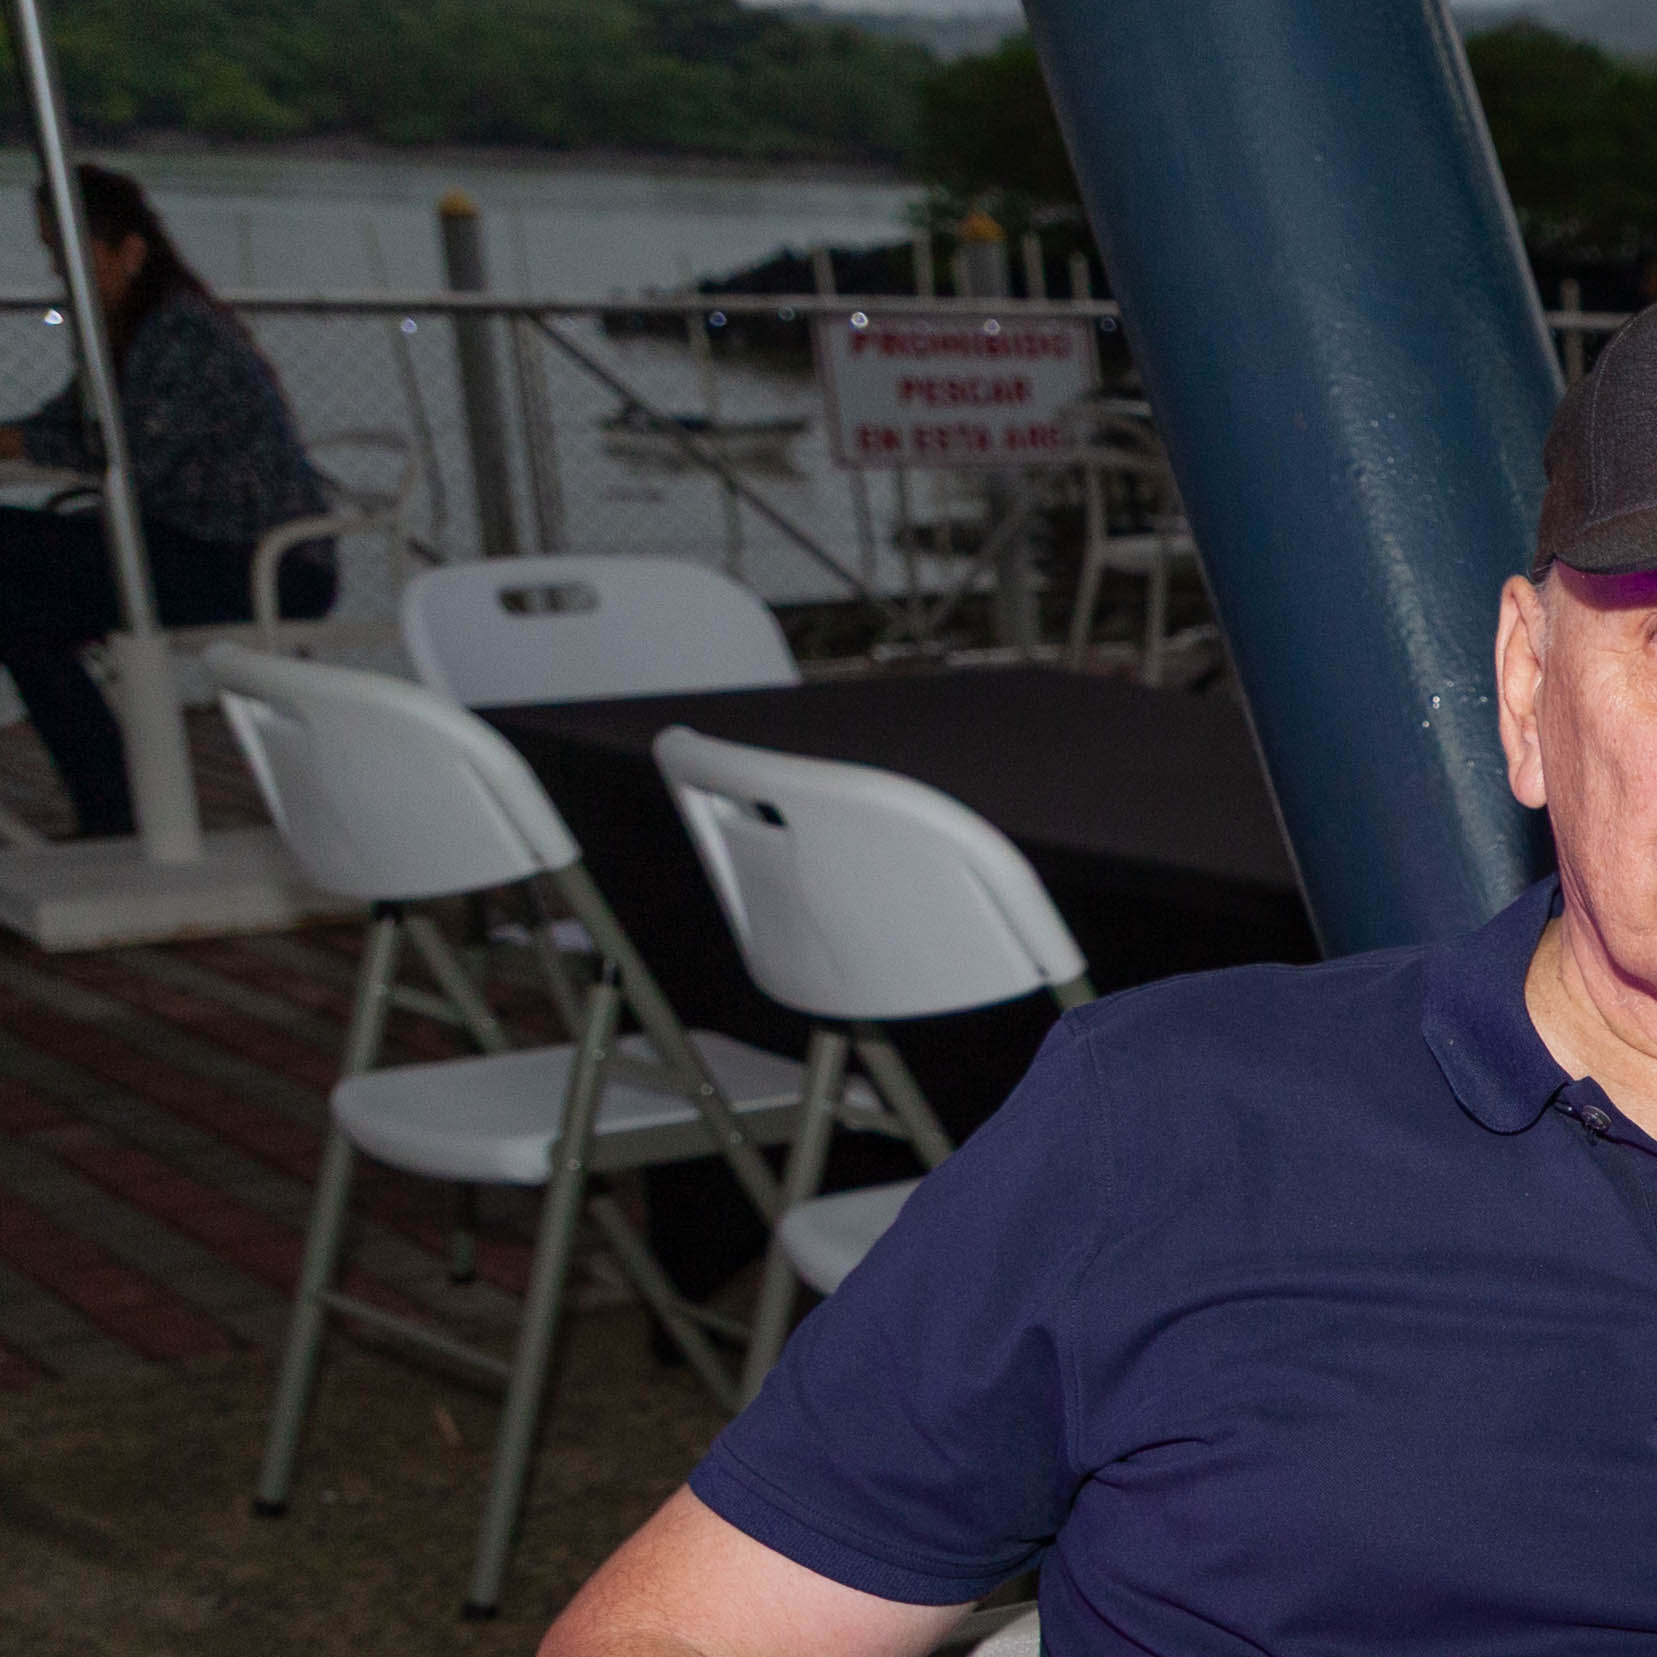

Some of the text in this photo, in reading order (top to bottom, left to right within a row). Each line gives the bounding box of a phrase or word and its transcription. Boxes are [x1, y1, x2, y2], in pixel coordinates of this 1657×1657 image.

[852, 332, 1070, 357] PROHIBIDO
[900, 376, 1030, 404] PESCAR
[857, 424, 901, 450] EN
[913, 424, 991, 450] ESTA
